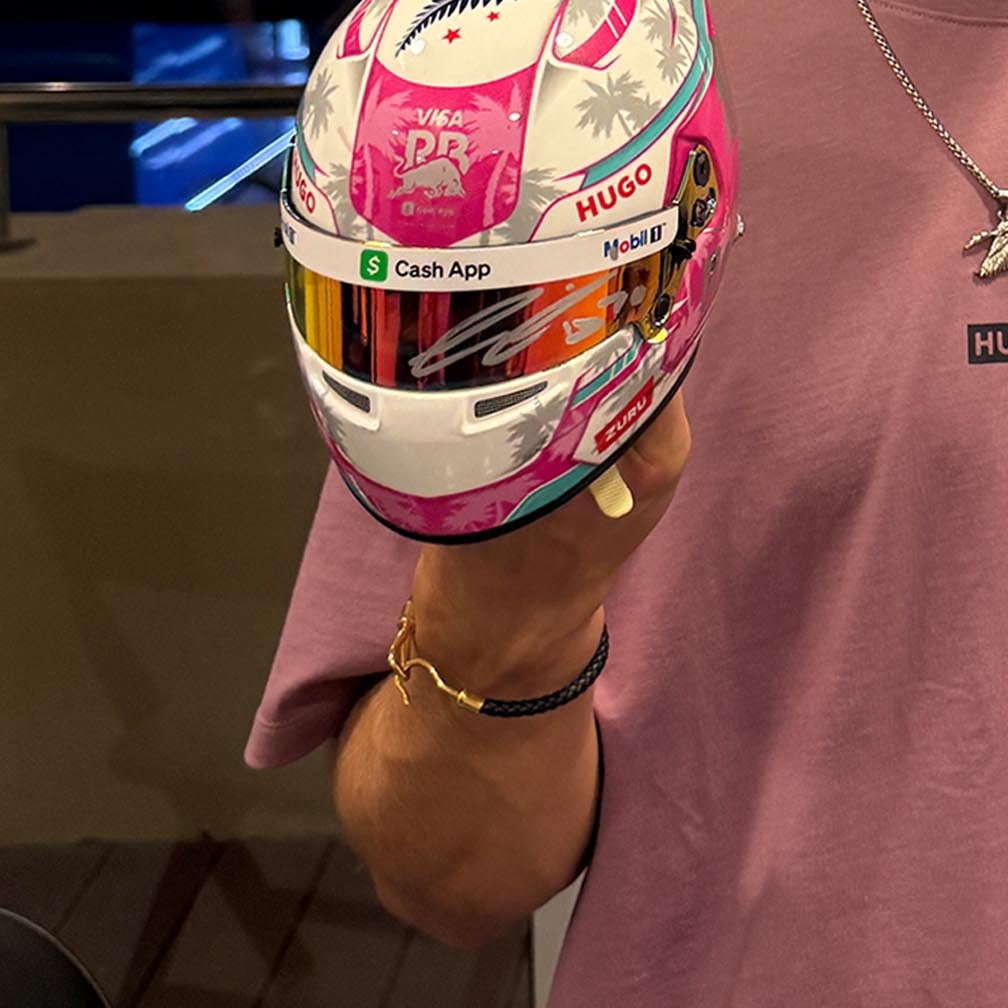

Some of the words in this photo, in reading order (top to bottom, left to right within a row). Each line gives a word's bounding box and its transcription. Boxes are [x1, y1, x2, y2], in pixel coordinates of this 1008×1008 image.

[417, 108, 463, 127] VISA
[576, 163, 652, 222] HUGO
[603, 229, 648, 261] Mobil
[395, 260, 444, 278] Cash
[448, 260, 491, 281] App
[604, 395, 647, 442] ZURU
